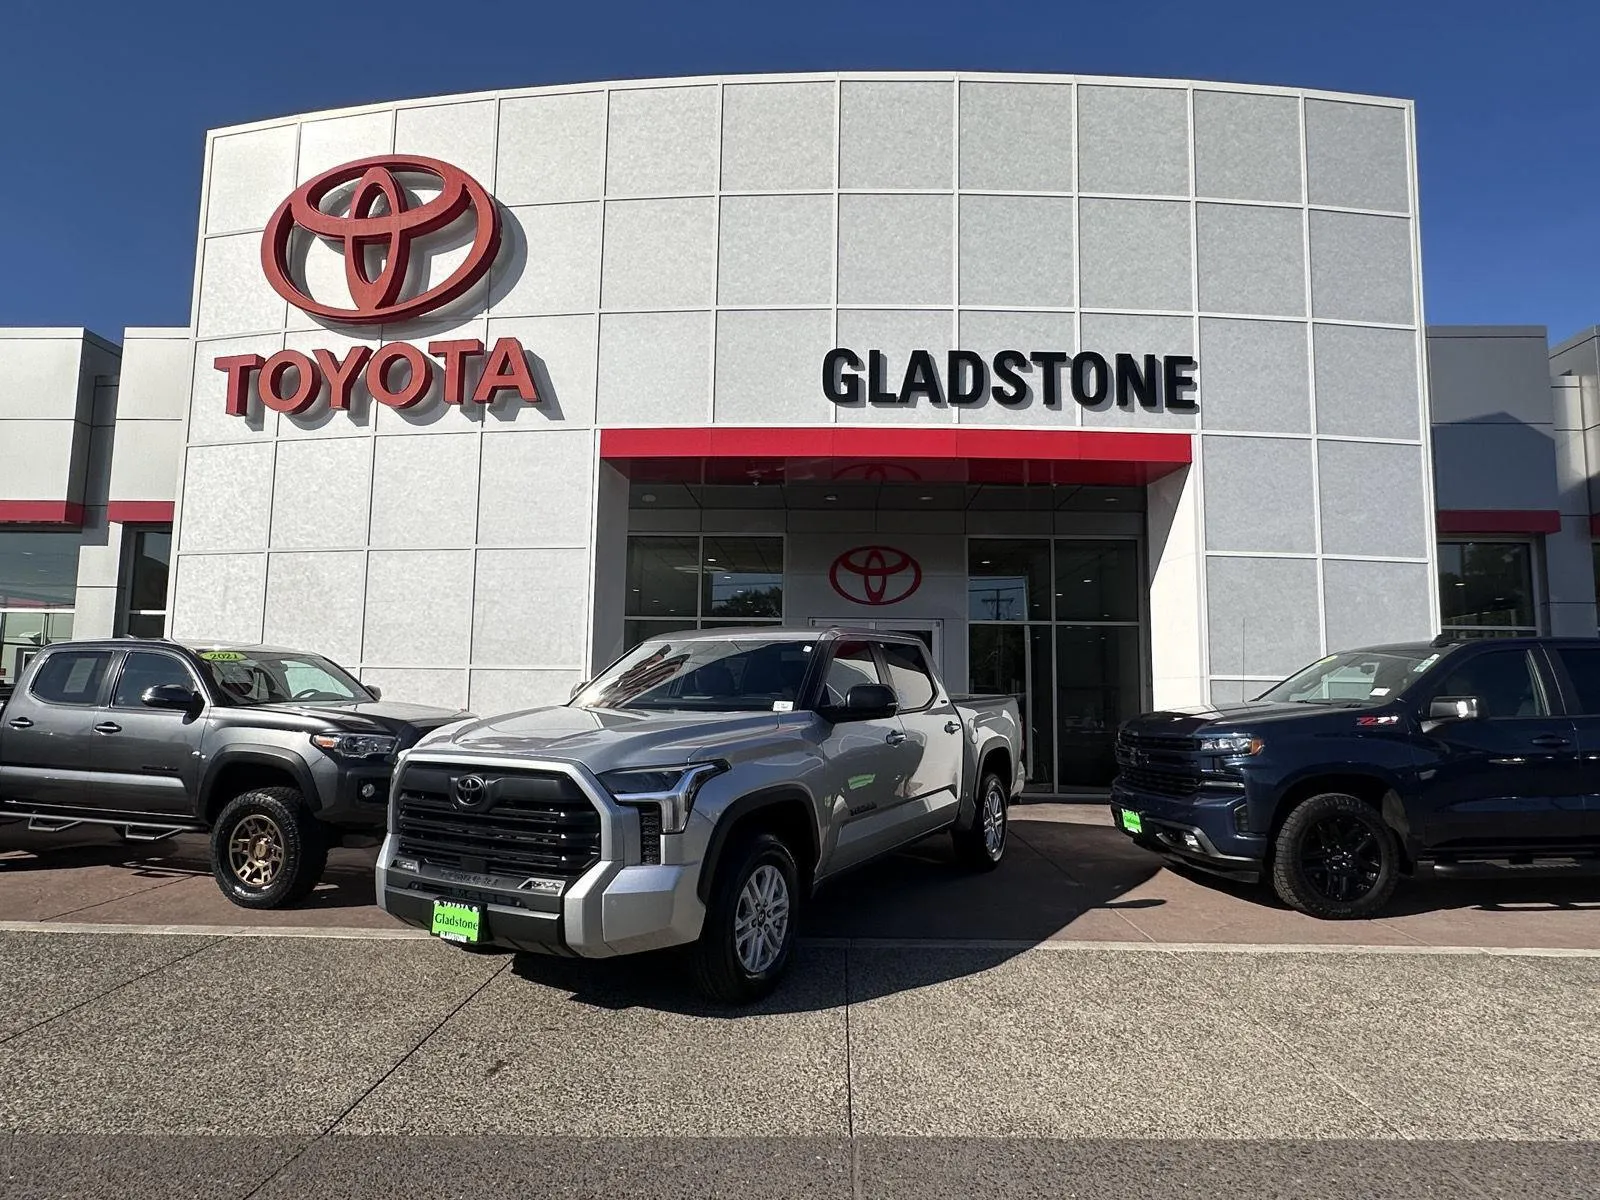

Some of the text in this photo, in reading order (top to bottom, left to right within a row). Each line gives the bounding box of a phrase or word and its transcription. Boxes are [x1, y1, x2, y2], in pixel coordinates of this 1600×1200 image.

[214, 337, 542, 417] TOYOTA
[822, 347, 1196, 410] GLADSTONE
[1356, 714, 1398, 725] Z71
[442, 900, 469, 909] TOYOTA
[434, 913, 478, 930] Gladstone
